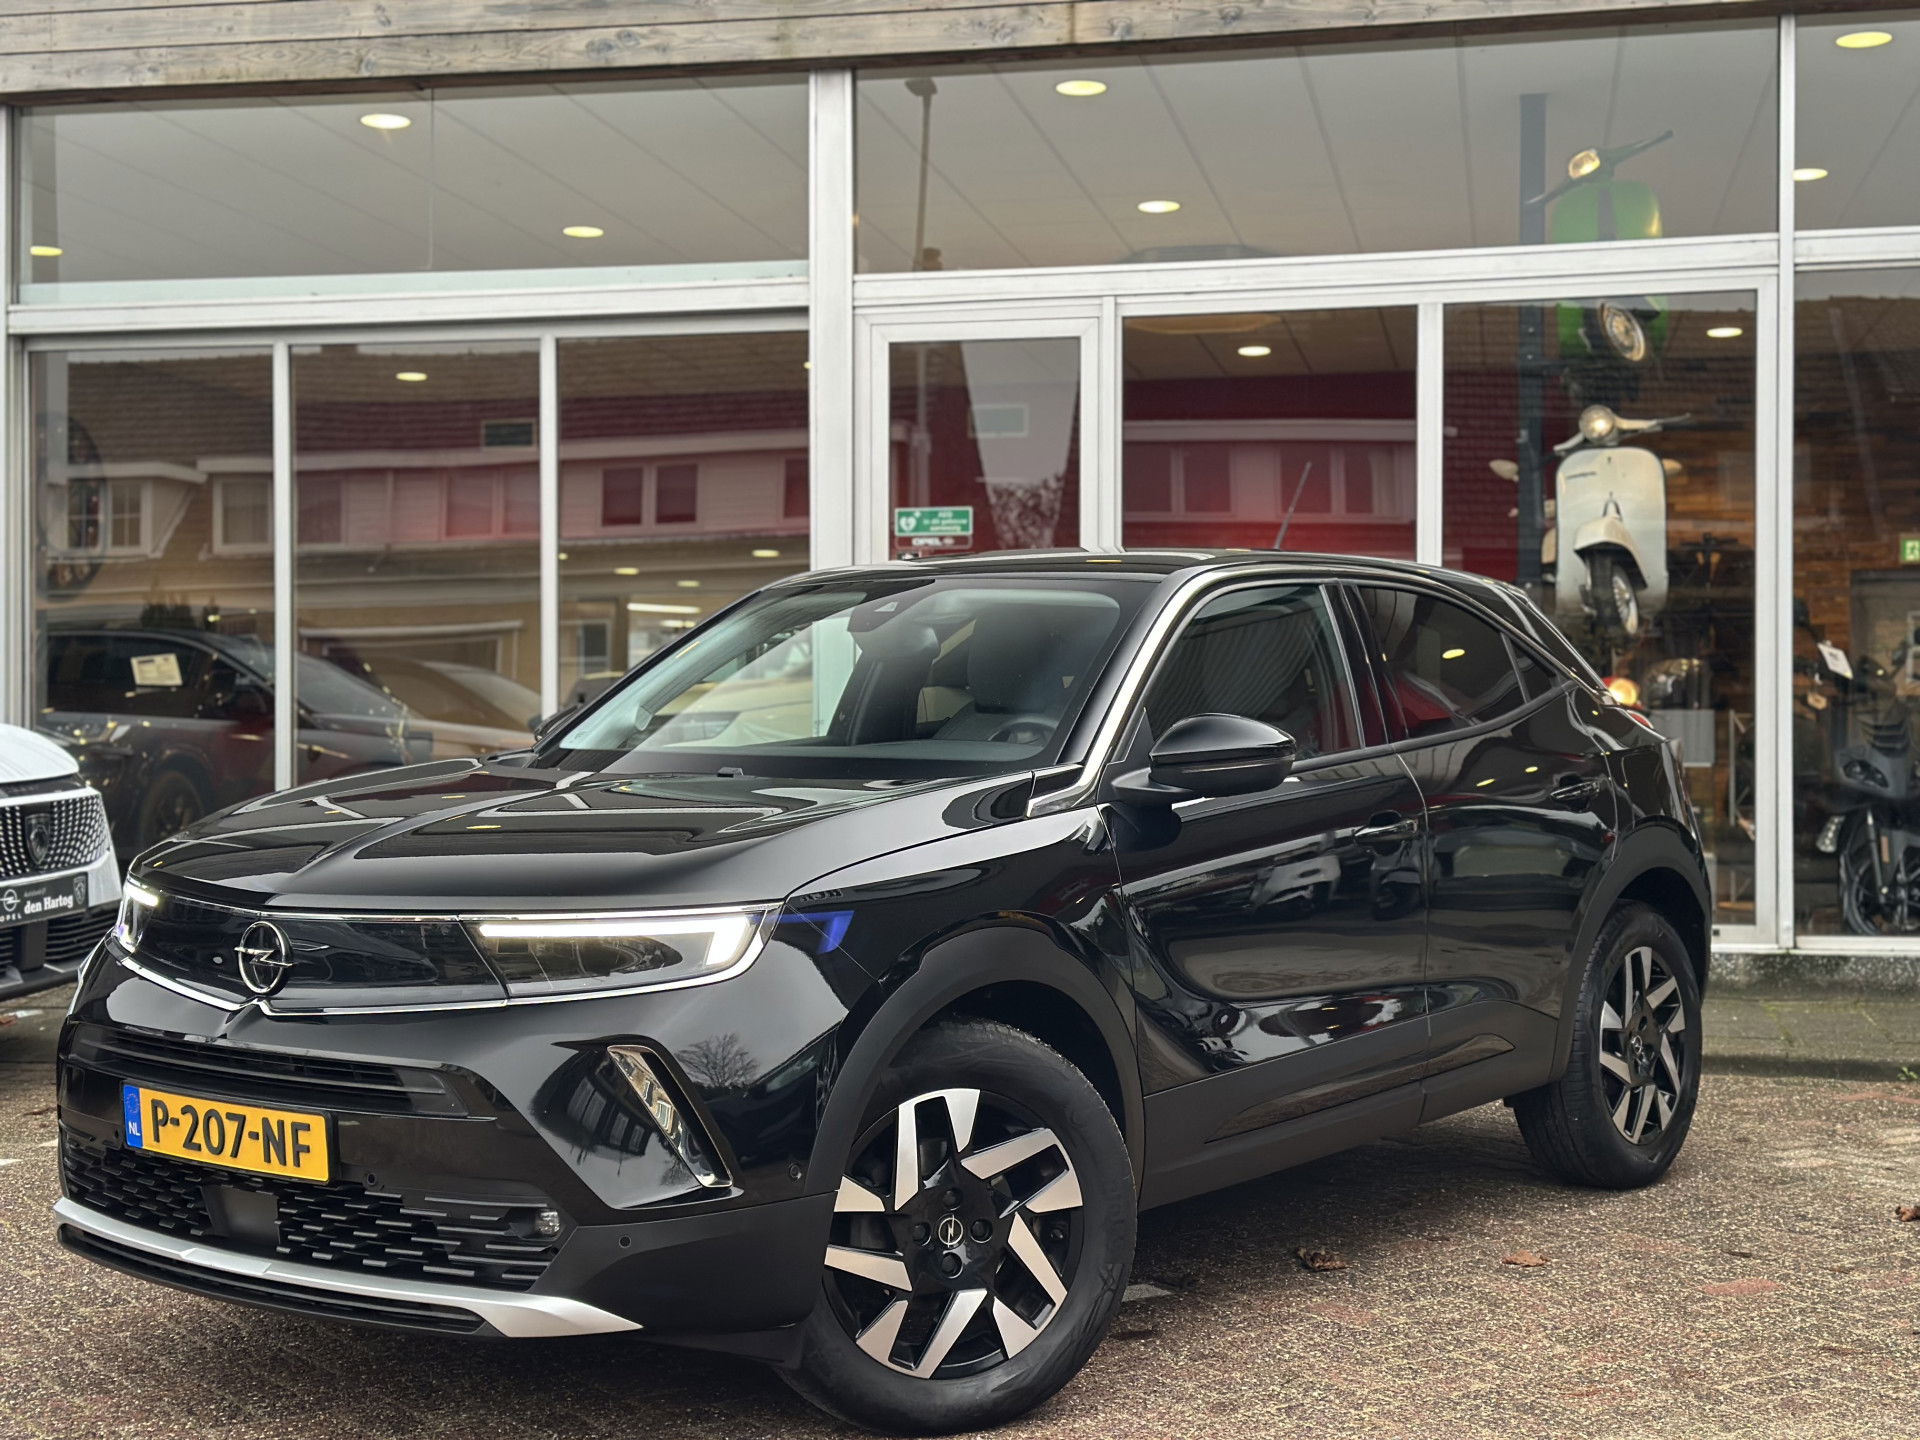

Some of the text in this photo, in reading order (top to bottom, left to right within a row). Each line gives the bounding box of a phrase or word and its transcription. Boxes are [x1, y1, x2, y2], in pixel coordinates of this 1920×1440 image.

[911, 537, 942, 546] OPEL
[24, 894, 74, 914] den Hartog
[128, 1121, 141, 1136] NL
[150, 1099, 311, 1168] P-207-NF
